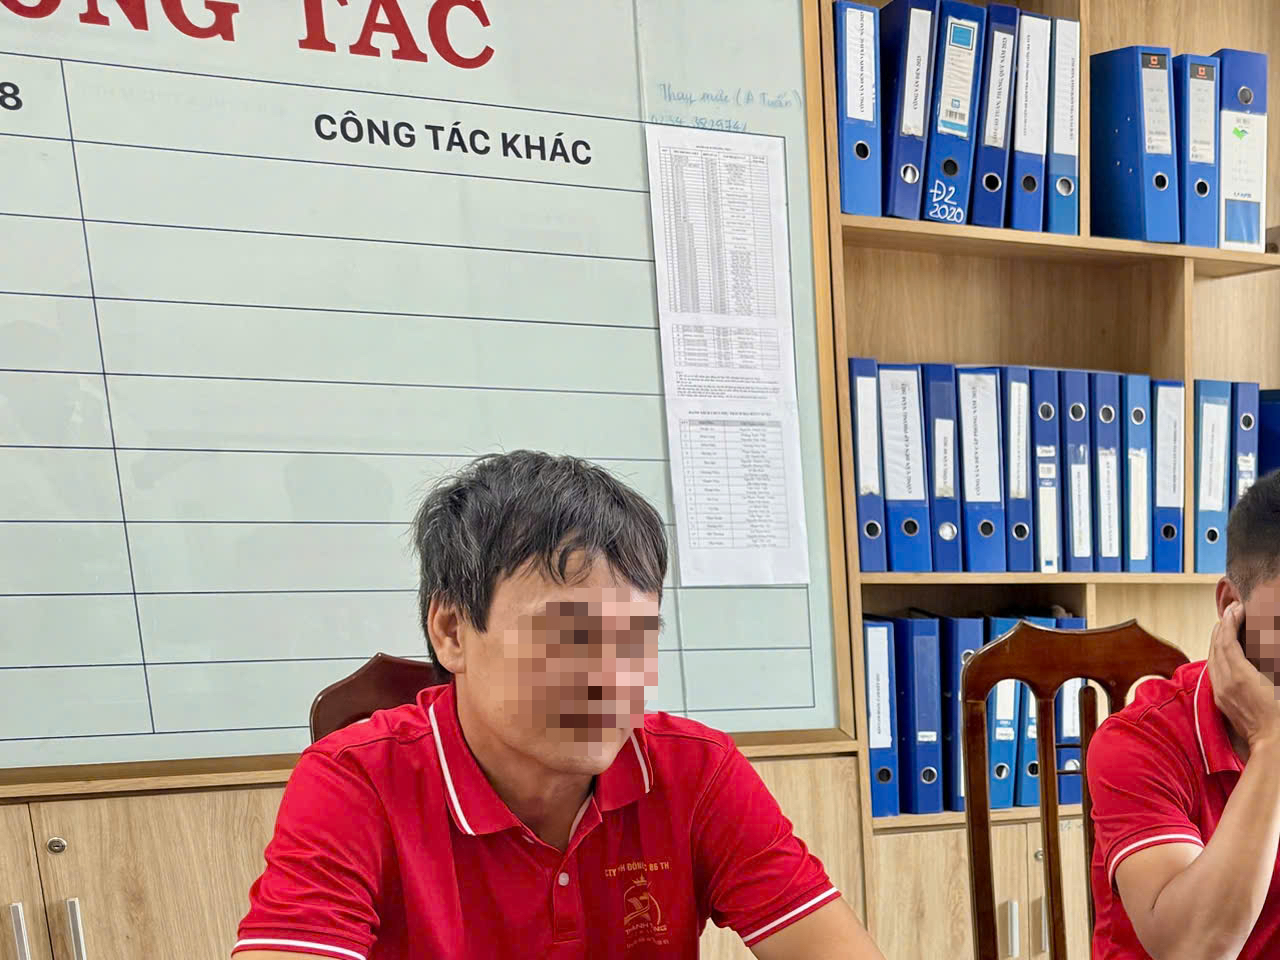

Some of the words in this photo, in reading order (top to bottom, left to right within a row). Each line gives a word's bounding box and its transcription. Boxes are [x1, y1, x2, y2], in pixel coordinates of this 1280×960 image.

[314, 111, 416, 149] CÔNG
[425, 121, 491, 155] TÁC
[501, 127, 592, 165] KHÁC
[929, 179, 957, 207] Đ2
[928, 203, 965, 224] 2020
